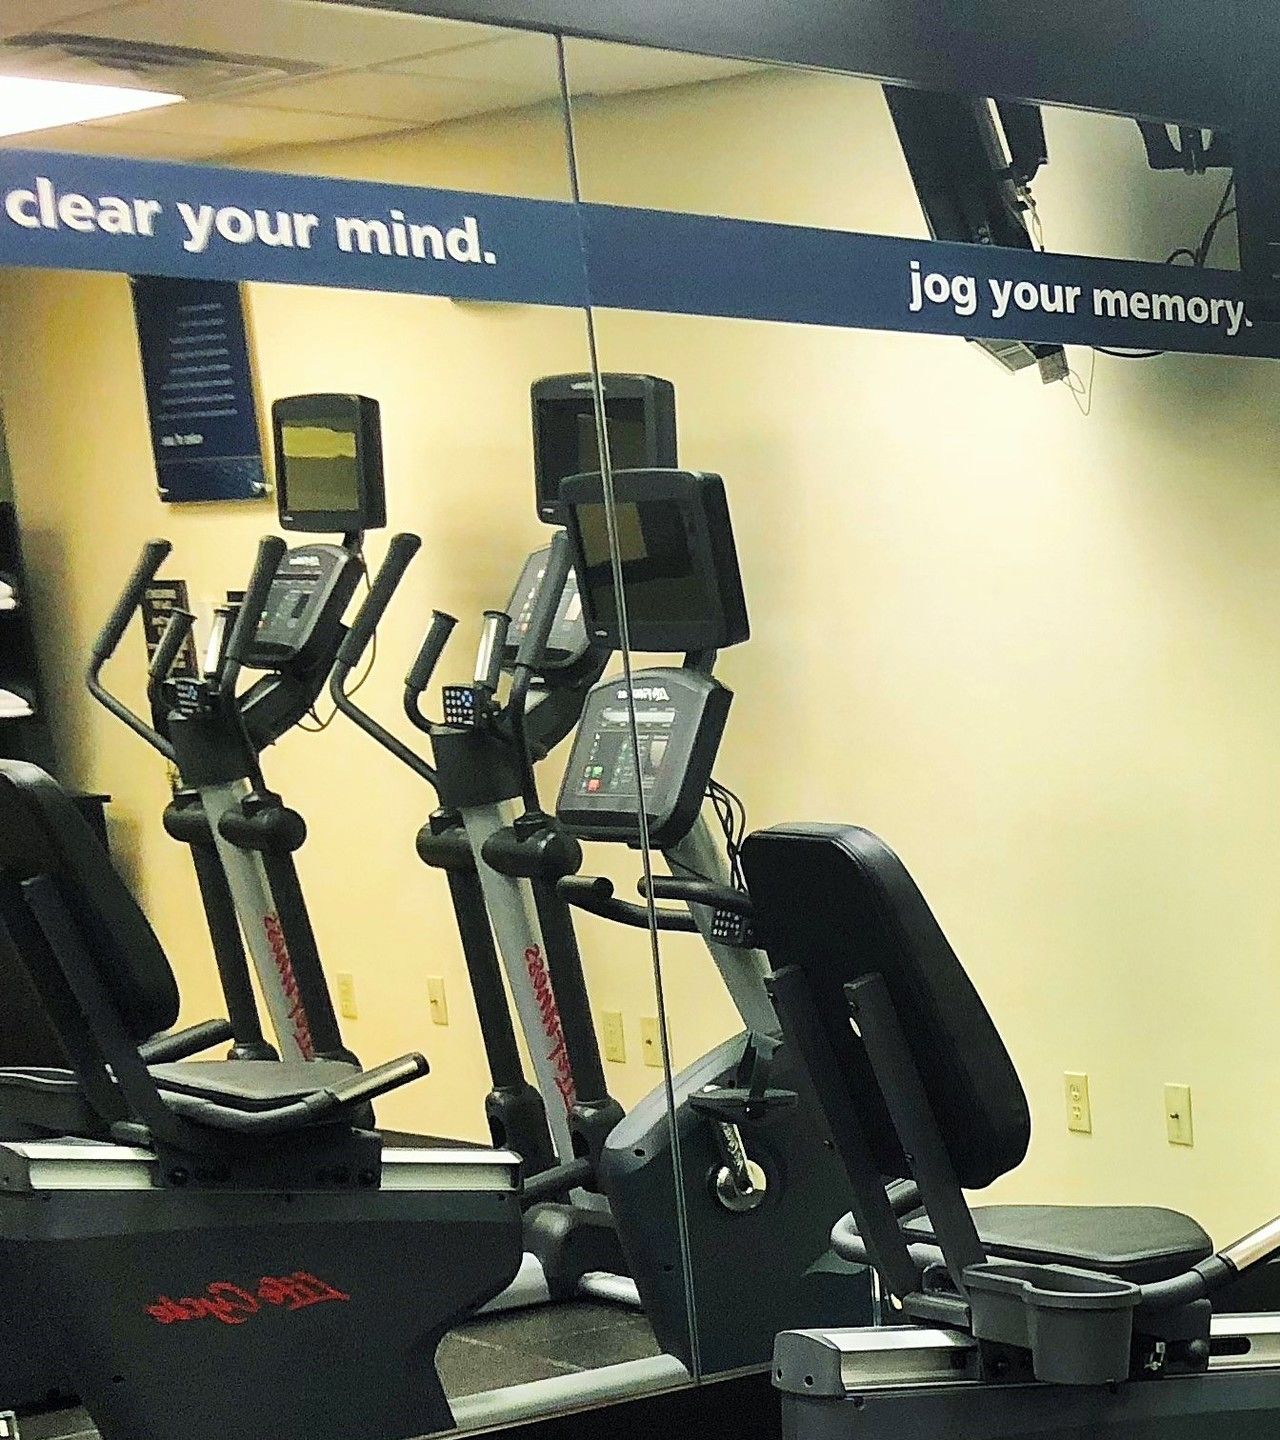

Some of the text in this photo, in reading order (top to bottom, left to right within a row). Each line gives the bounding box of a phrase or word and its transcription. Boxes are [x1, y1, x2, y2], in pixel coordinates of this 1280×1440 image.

[6, 177, 497, 264] clear your mind.
[909, 260, 976, 315] jog
[988, 278, 1080, 318] your
